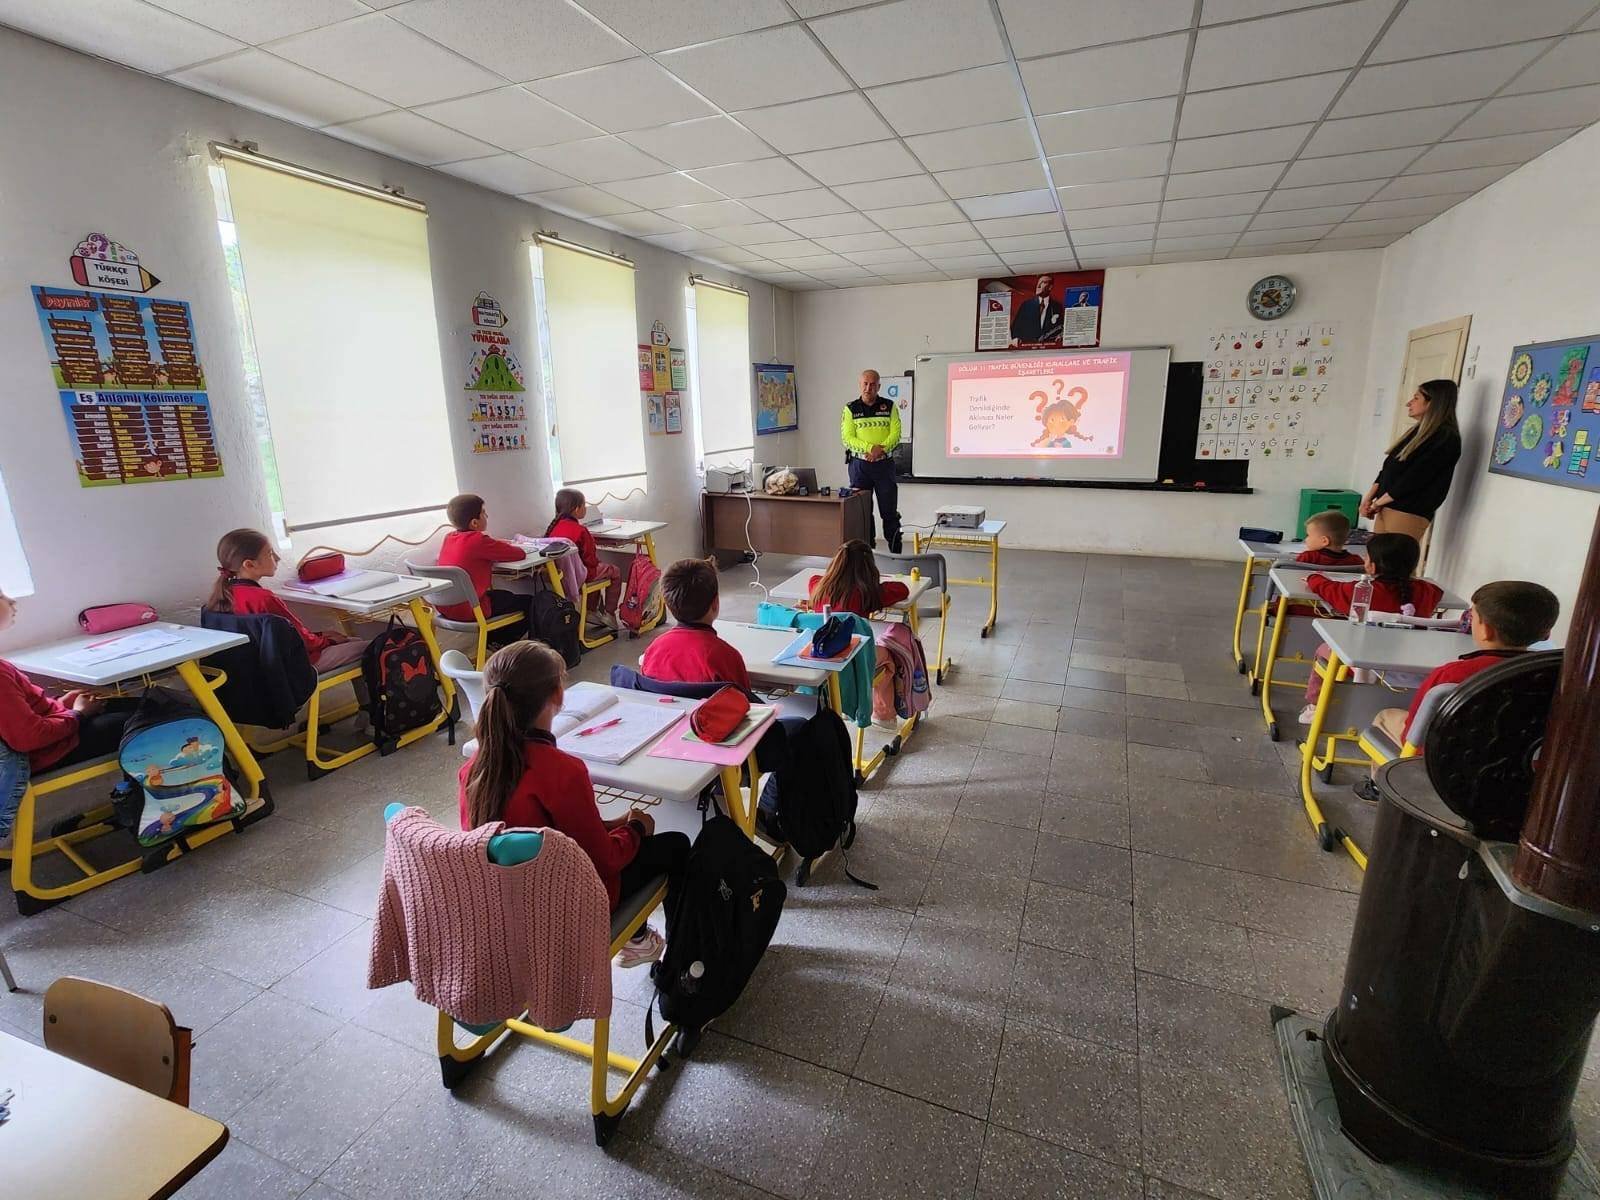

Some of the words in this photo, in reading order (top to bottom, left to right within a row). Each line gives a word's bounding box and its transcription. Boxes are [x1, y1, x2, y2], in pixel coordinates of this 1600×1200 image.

[94, 262, 128, 275] TÜRKÇE
[98, 275, 129, 286] KÖŞESİ
[471, 333, 511, 345] YUVARLAMA
[888, 385, 898, 397] a
[80, 393, 93, 404] Eş
[98, 393, 141, 403] Anlamlı
[144, 393, 194, 403] Kelimeler
